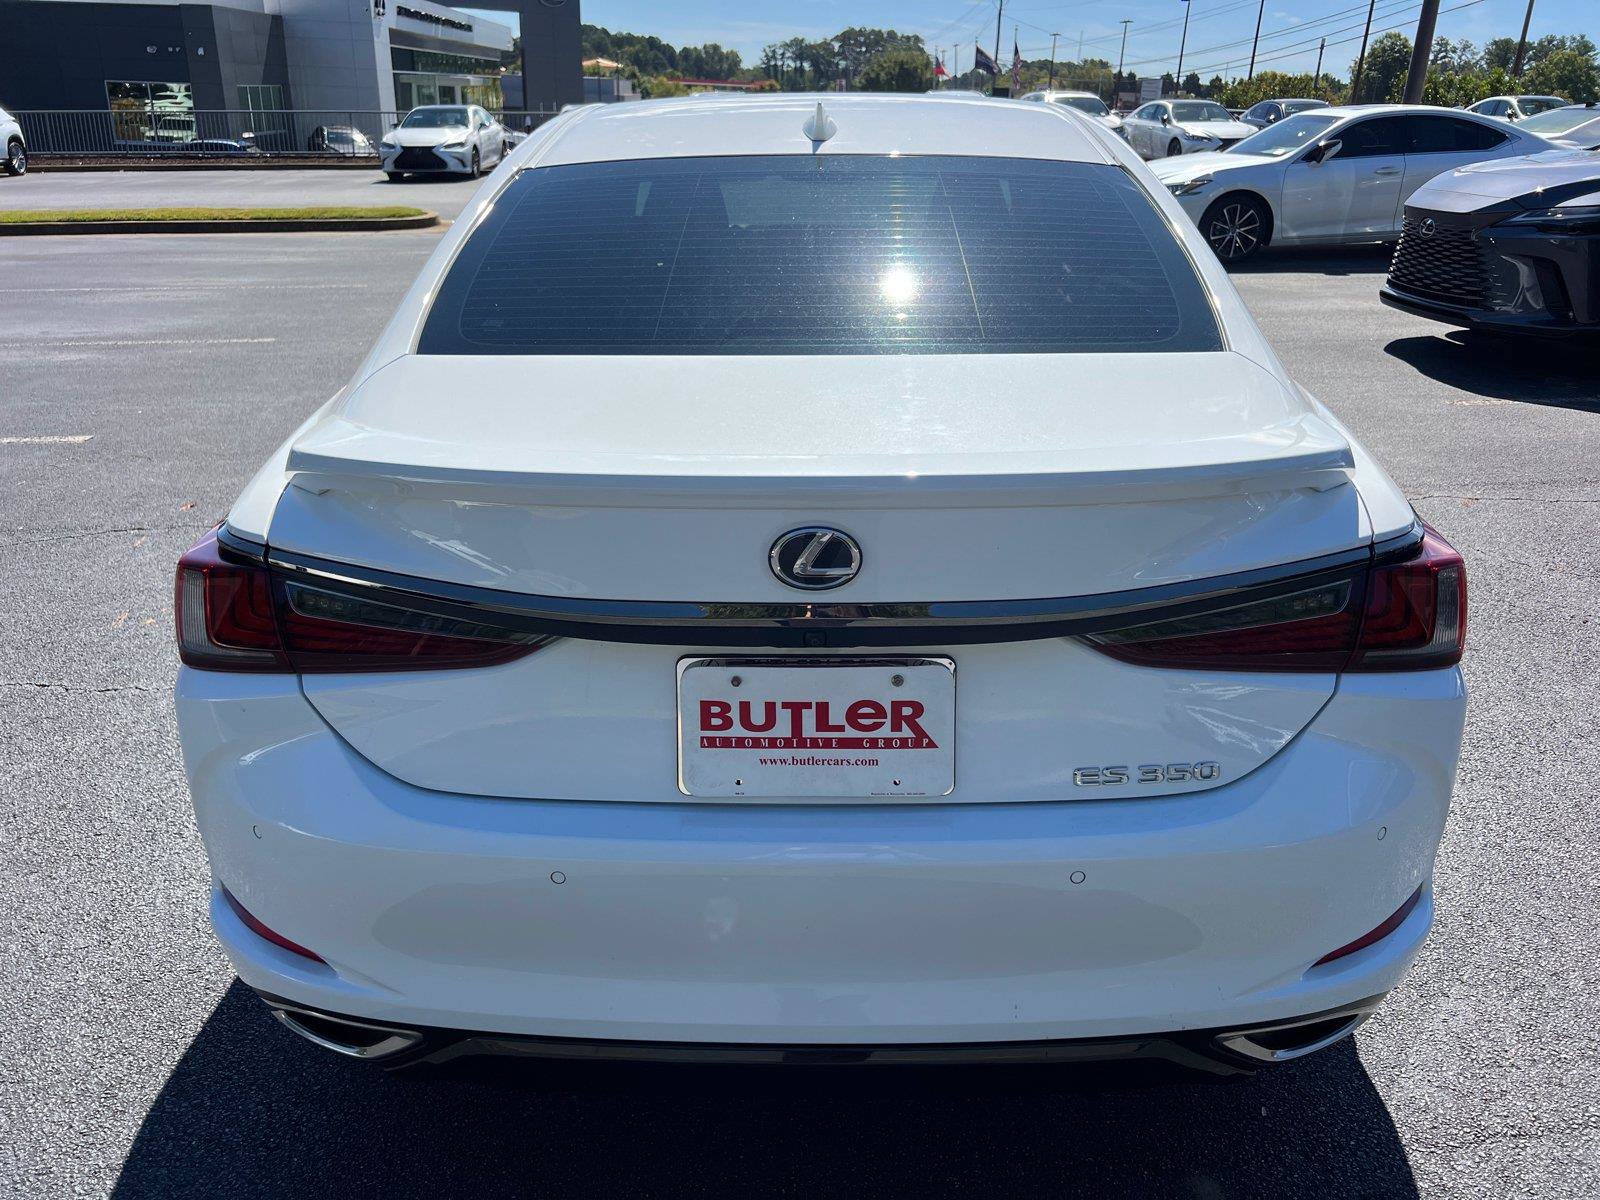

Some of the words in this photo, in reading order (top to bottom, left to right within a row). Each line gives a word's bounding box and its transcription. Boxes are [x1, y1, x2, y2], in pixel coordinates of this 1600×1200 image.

[701, 738, 839, 748] AUTOMOTIVE
[863, 738, 929, 748] GROUP
[759, 756, 879, 766] www.butlercars.com
[1073, 766, 1129, 786] ES
[1138, 761, 1220, 784] 350
